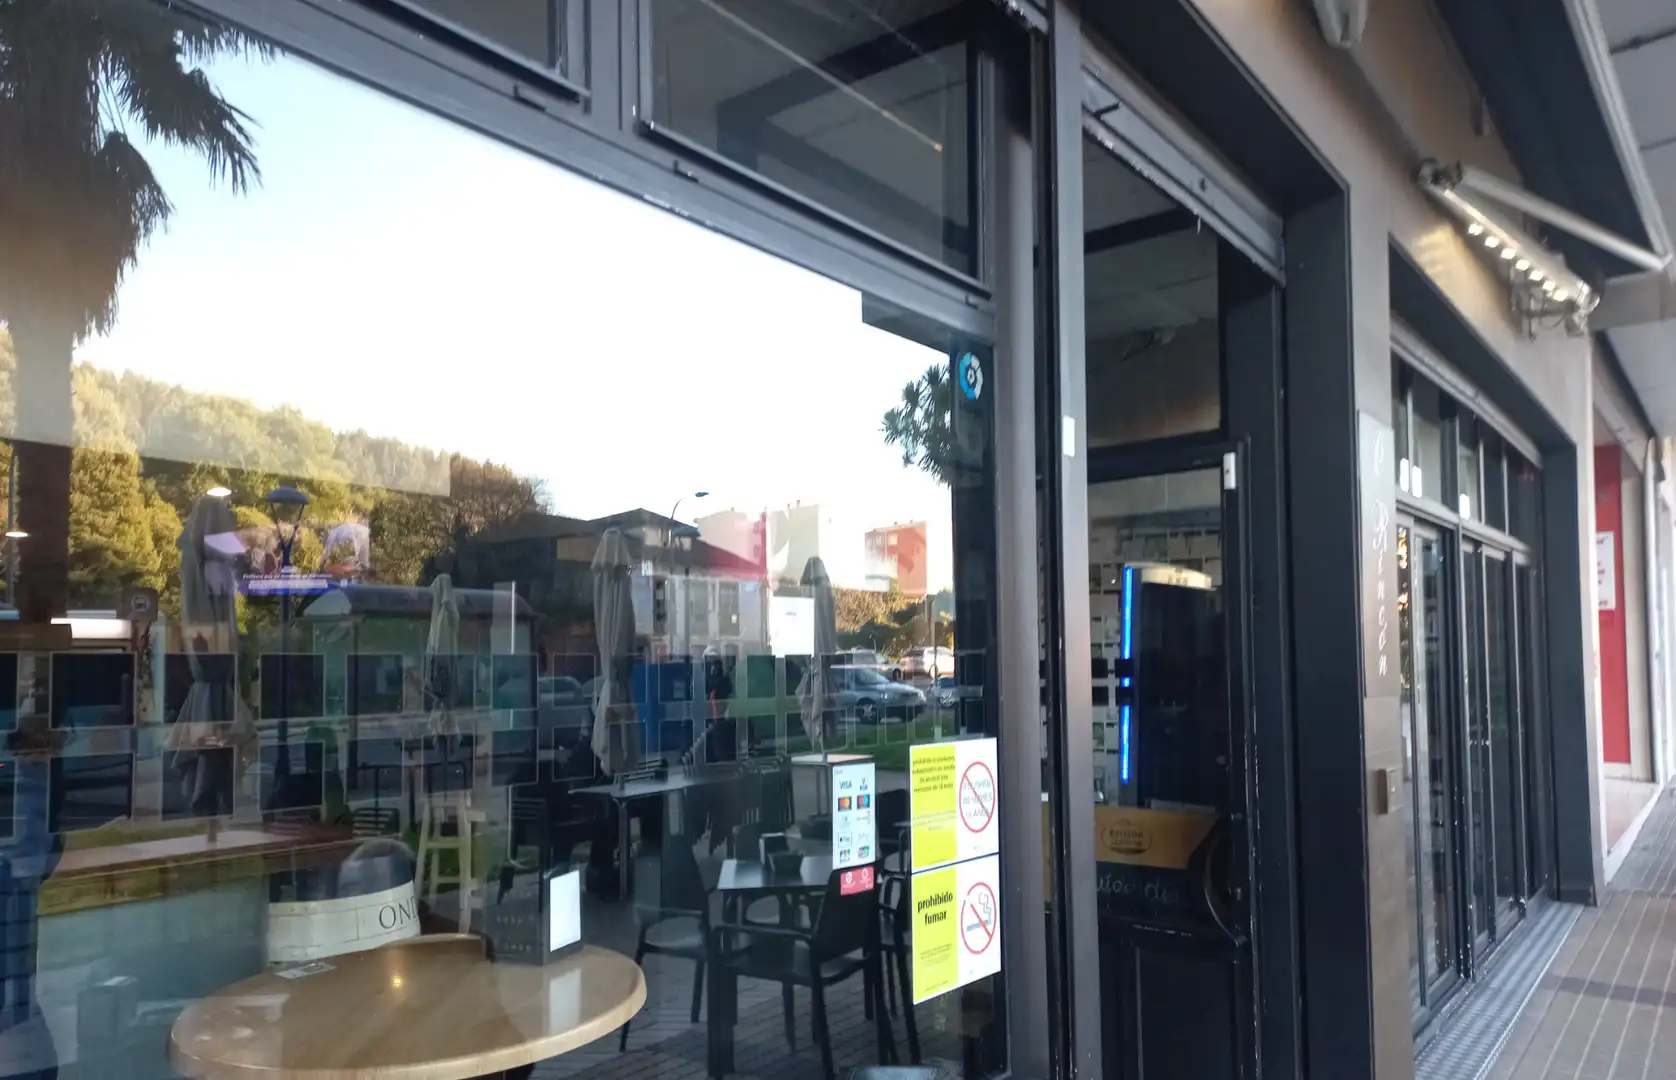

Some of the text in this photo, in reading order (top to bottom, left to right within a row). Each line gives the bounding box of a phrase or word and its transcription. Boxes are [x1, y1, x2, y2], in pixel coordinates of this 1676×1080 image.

[839, 780, 853, 790] VISA
[917, 890, 953, 914] prohibido
[924, 910, 947, 925] fumar
